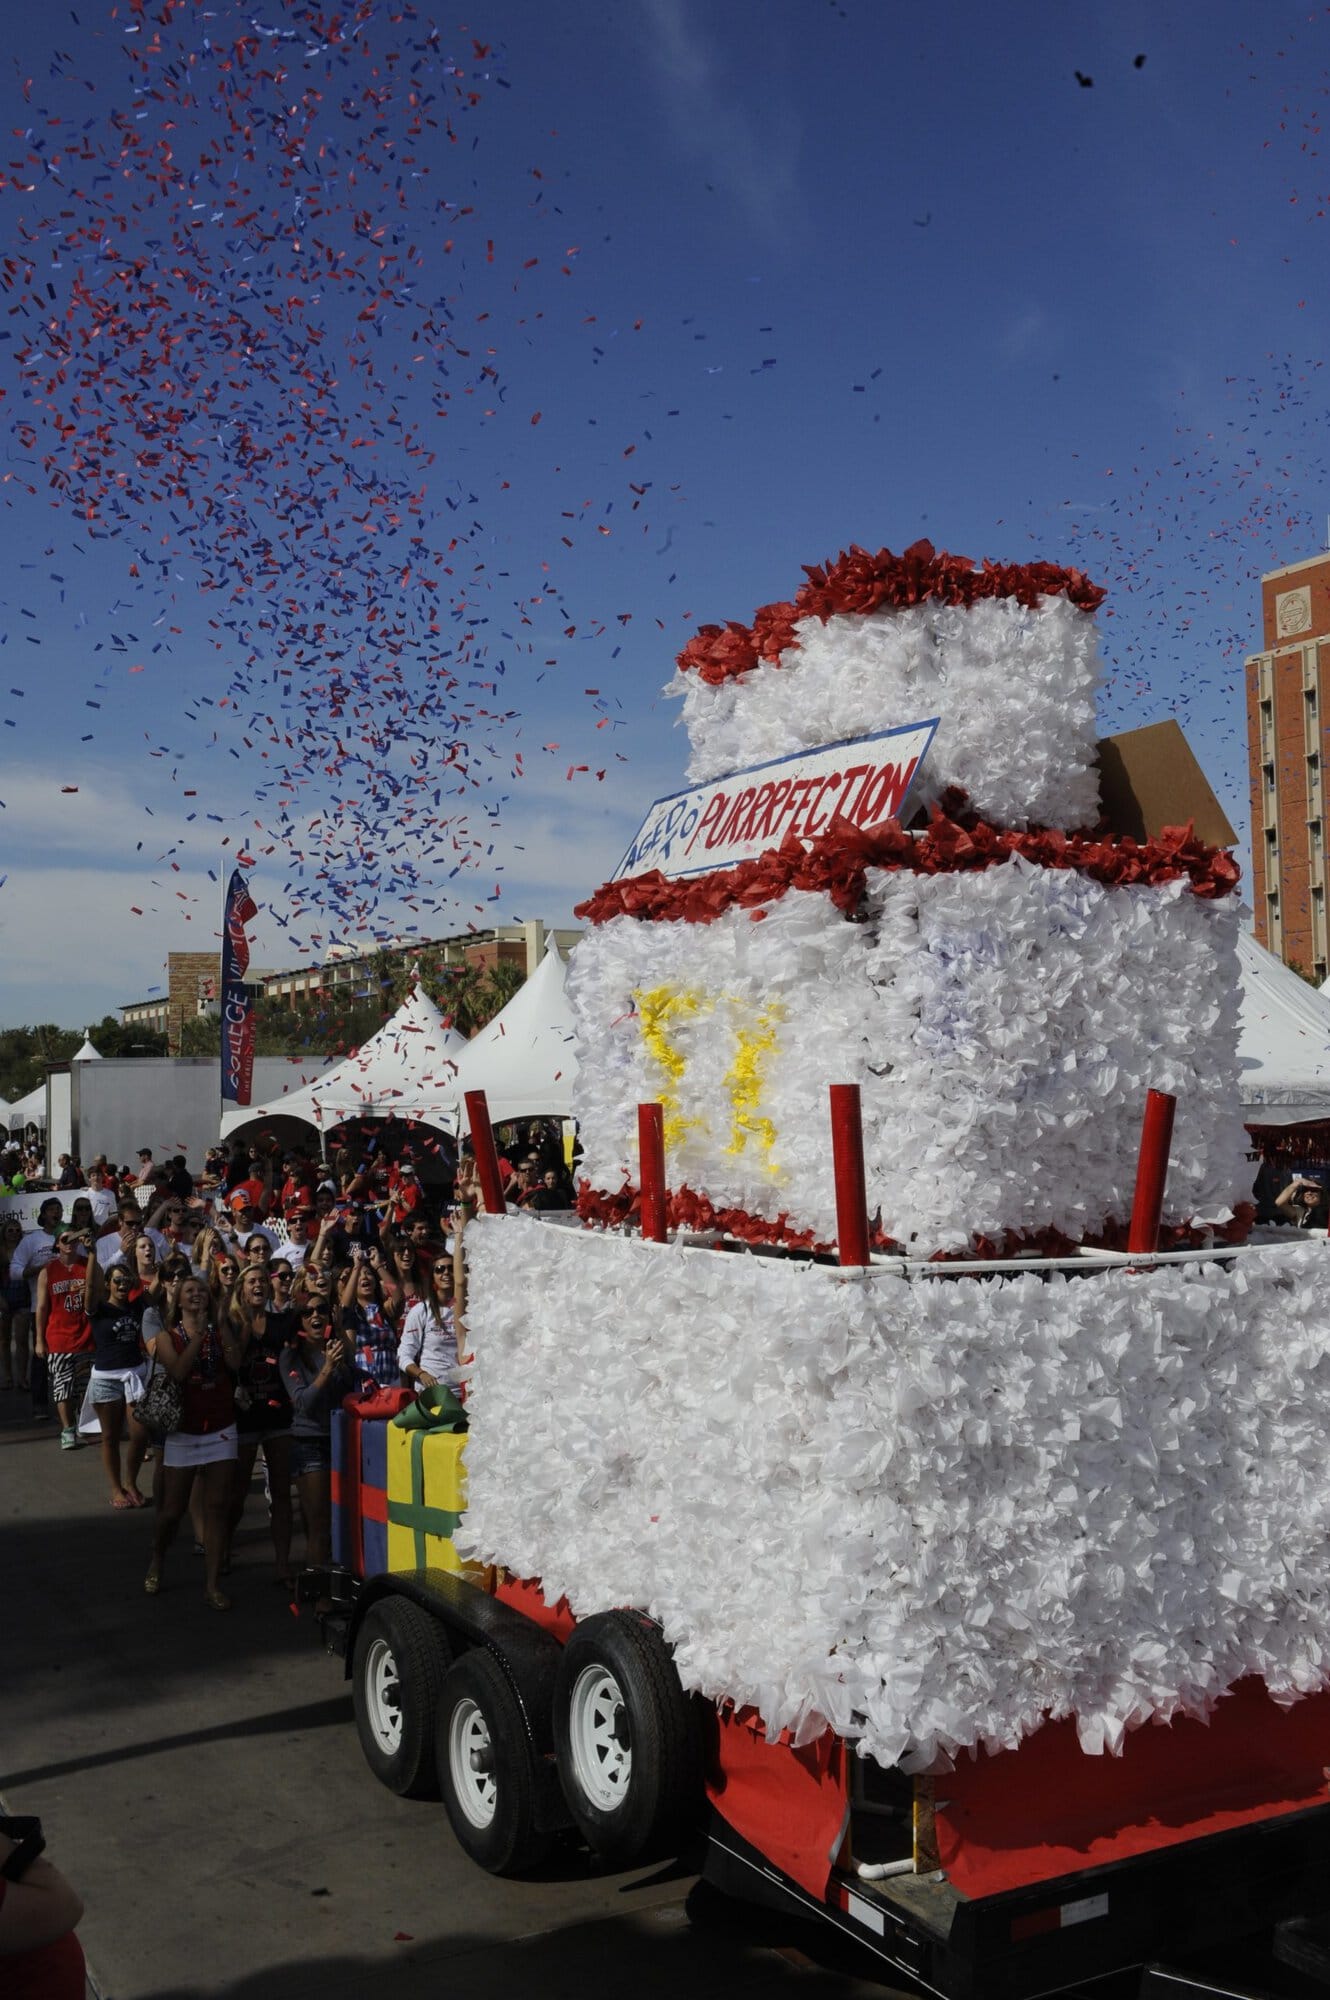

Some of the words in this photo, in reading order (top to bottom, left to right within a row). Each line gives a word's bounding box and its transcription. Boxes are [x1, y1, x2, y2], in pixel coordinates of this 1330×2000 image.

[620, 799, 688, 877] AGED
[684, 757, 919, 855] PURRRFECTION
[225, 990, 248, 1089] COLLEGE
